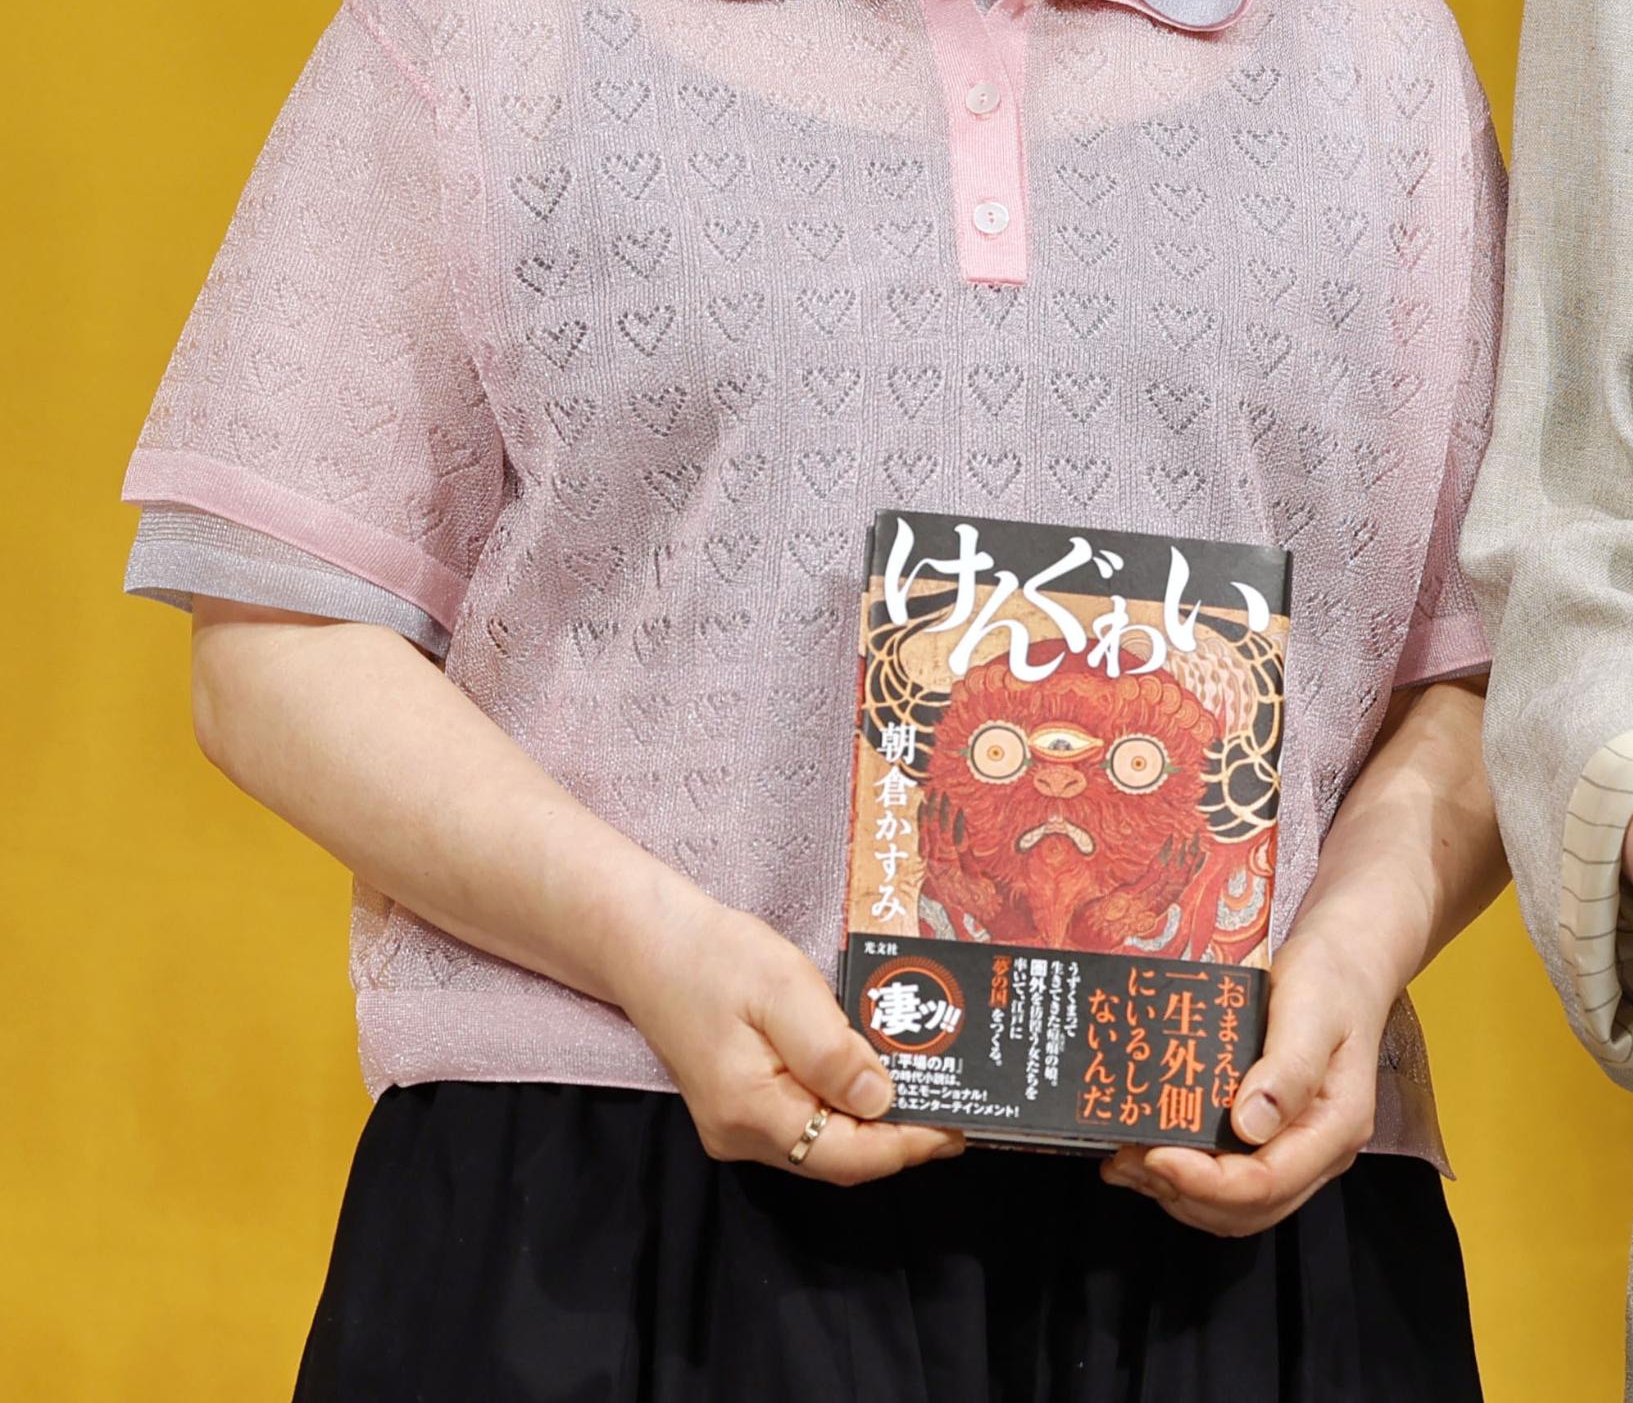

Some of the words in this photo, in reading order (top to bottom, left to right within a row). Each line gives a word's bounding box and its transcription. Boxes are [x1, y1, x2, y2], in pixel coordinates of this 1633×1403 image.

[871, 720, 918, 922] 朝倉かすみ
[893, 1082, 988, 1102] もエモーショナル！
[1076, 988, 1121, 1126] ないんだ」
[1119, 966, 1156, 1126] にいるしか
[1157, 971, 1209, 1133] 一生外側
